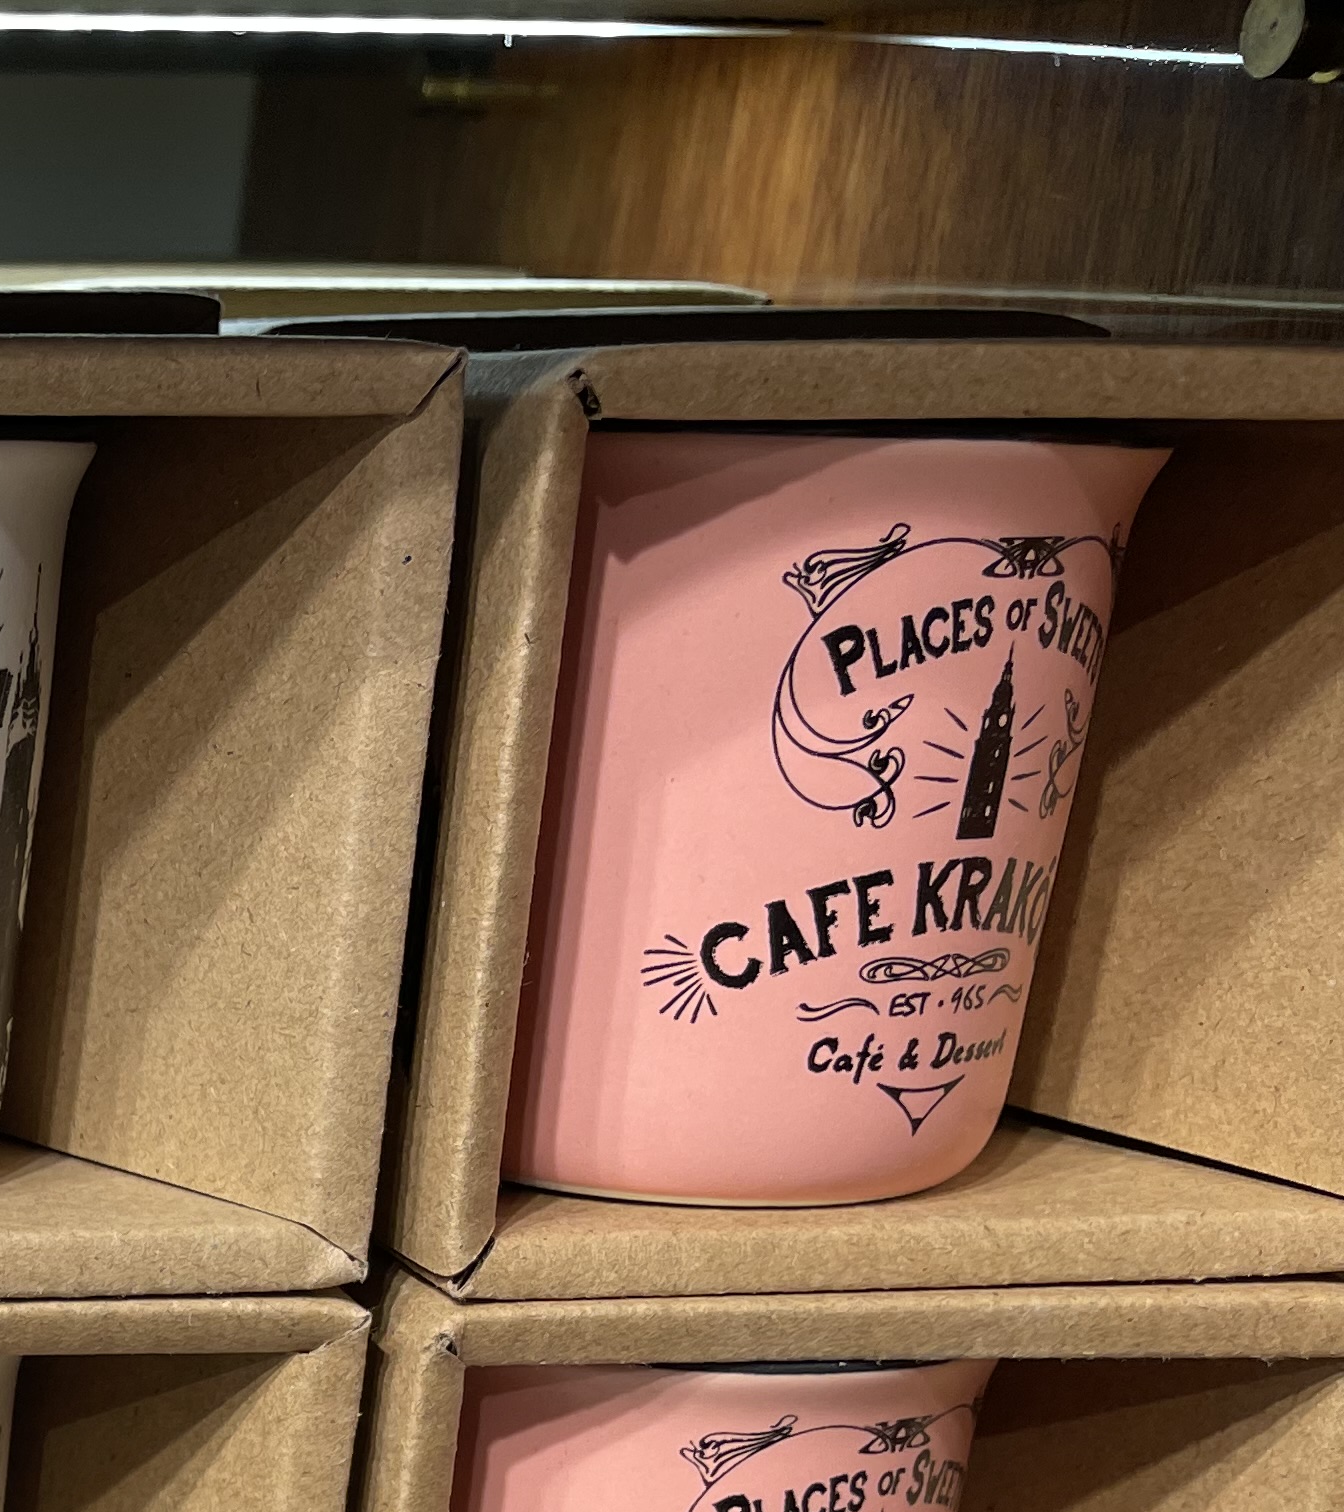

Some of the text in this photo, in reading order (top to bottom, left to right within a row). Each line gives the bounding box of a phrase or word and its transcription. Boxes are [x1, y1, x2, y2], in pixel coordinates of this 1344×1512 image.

[821, 594, 995, 697] PLACES
[1005, 597, 1038, 632] OF
[700, 868, 894, 989] CAFE
[951, 984, 986, 1014] 965
[807, 1033, 884, 1085] Café
[898, 1037, 920, 1072] &
[877, 1467, 906, 1496] OF
